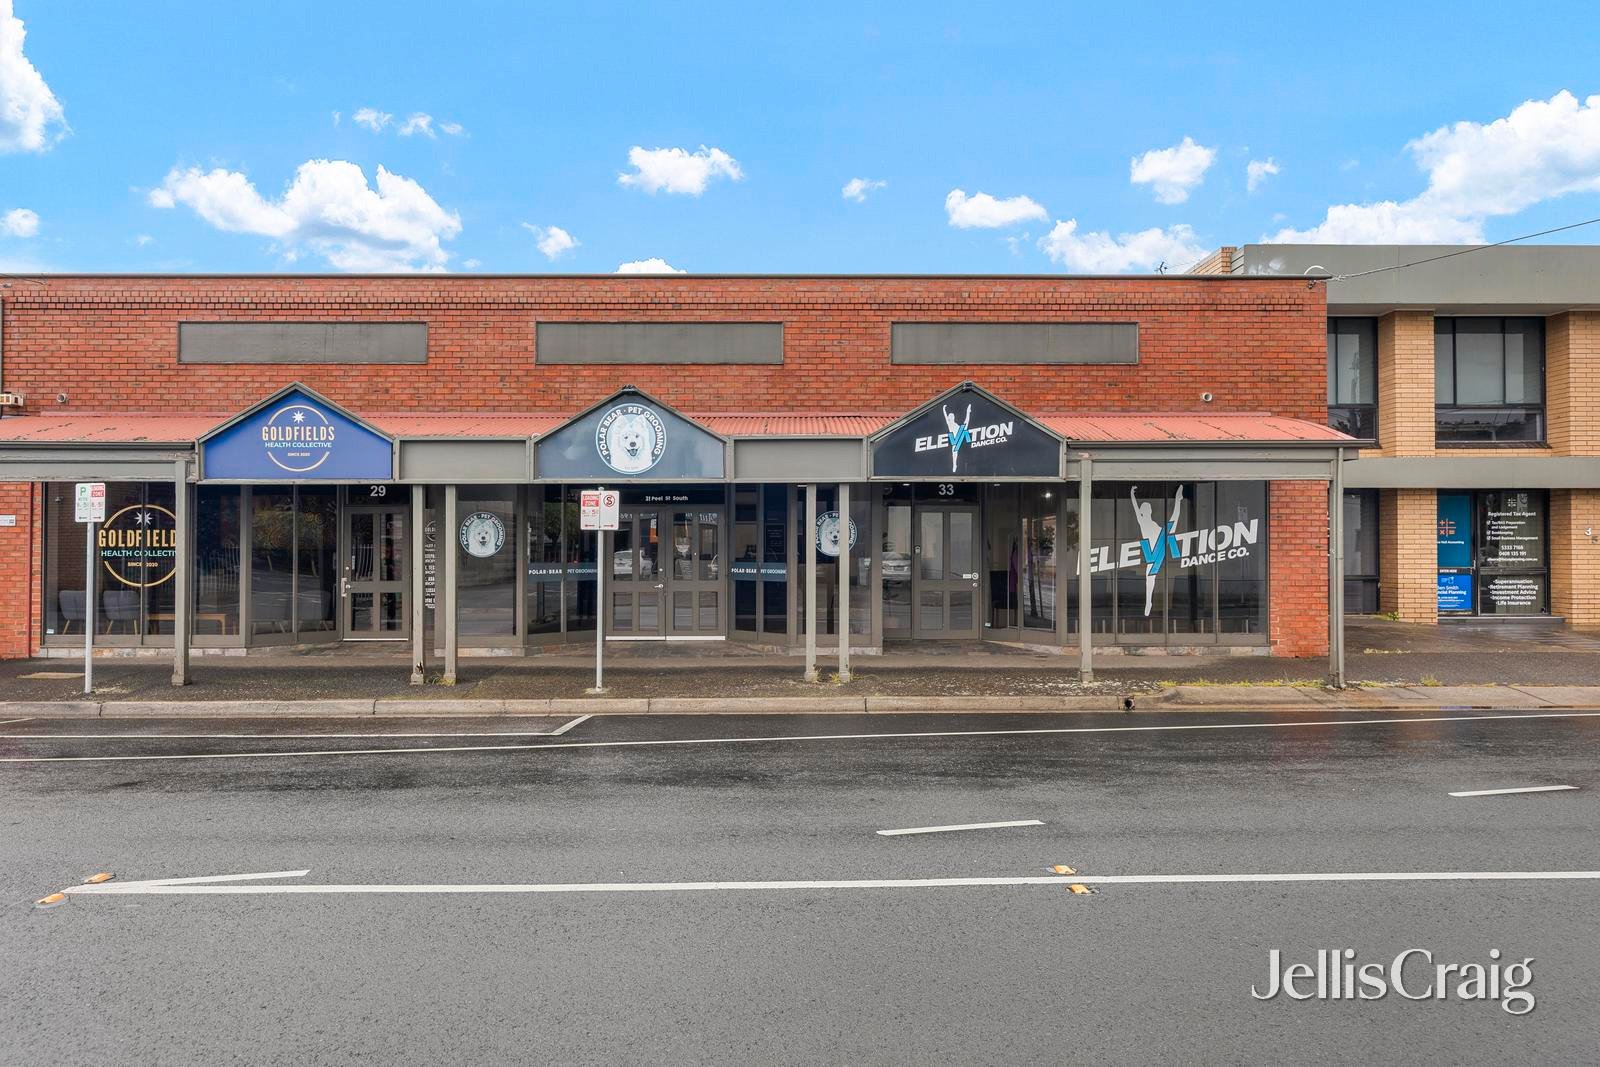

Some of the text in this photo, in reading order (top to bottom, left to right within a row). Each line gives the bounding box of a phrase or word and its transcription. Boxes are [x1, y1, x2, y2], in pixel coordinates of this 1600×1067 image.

[262, 426, 335, 441] GOLDFIELDS
[599, 407, 665, 455] POLAR BEAR PET GROOMING
[914, 421, 1014, 454] ELEVATION
[971, 437, 1008, 449] DANCE CO.
[80, 486, 86, 496] P
[370, 485, 386, 496] 29
[938, 484, 955, 496] 33
[98, 529, 176, 547] GOLDFIELD
[1076, 518, 1259, 576] ELEVATION
[1180, 546, 1250, 569] DANCE CO.
